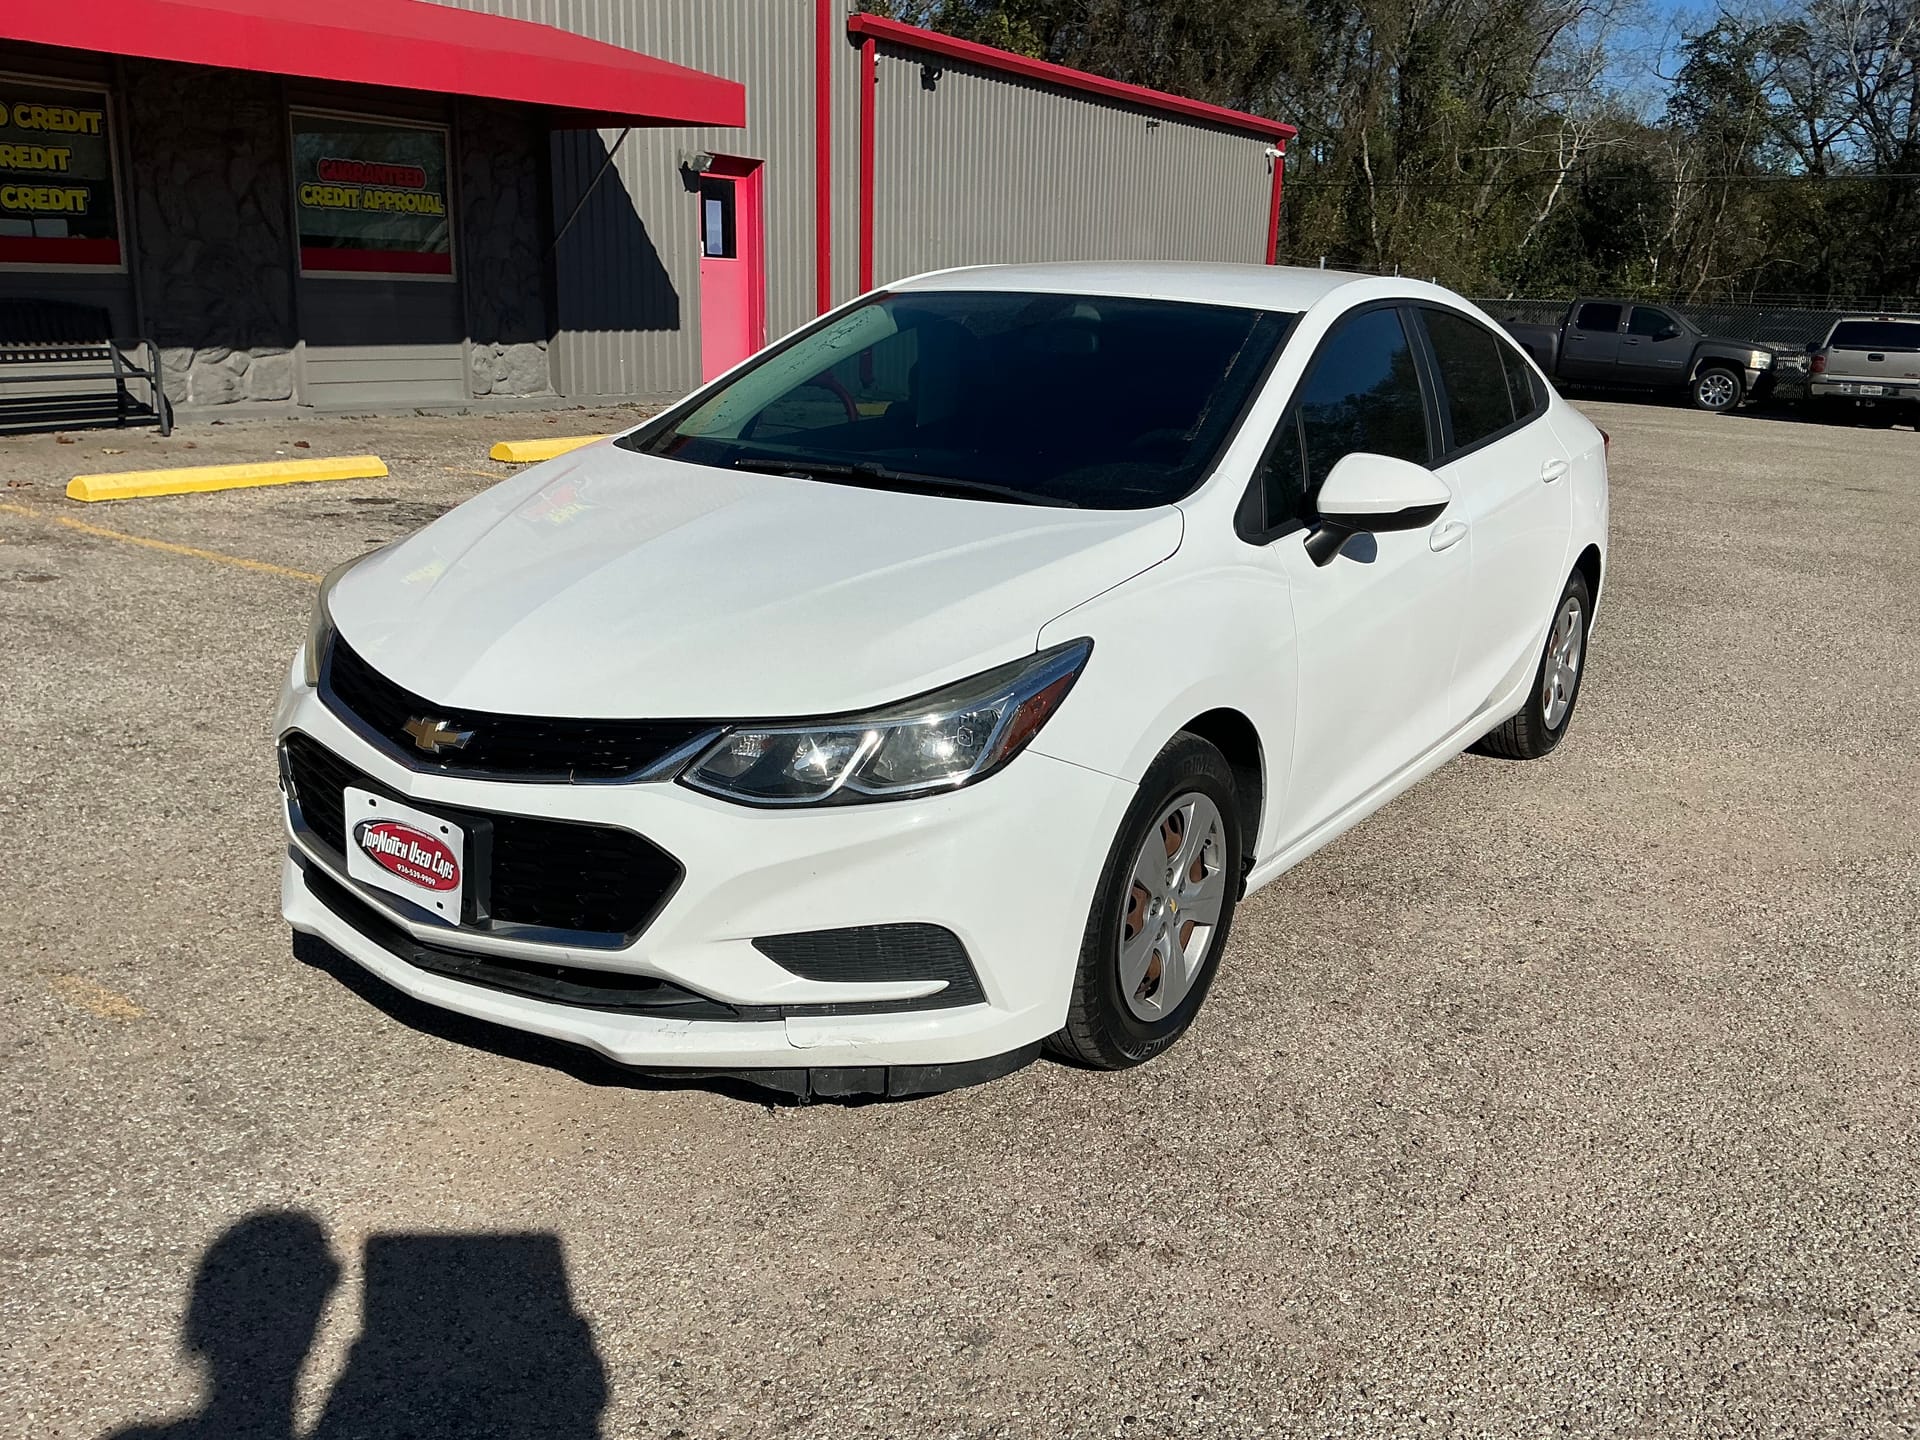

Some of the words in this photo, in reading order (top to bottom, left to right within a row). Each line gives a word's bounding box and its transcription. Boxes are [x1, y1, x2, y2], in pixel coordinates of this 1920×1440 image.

[14, 104, 102, 133] CREDIT
[0, 145, 70, 170] REDIT
[319, 160, 424, 186] GUARANTEED
[0, 186, 88, 211] CREDIT
[300, 184, 360, 209] CREDIT
[362, 190, 444, 213] APPROVAL
